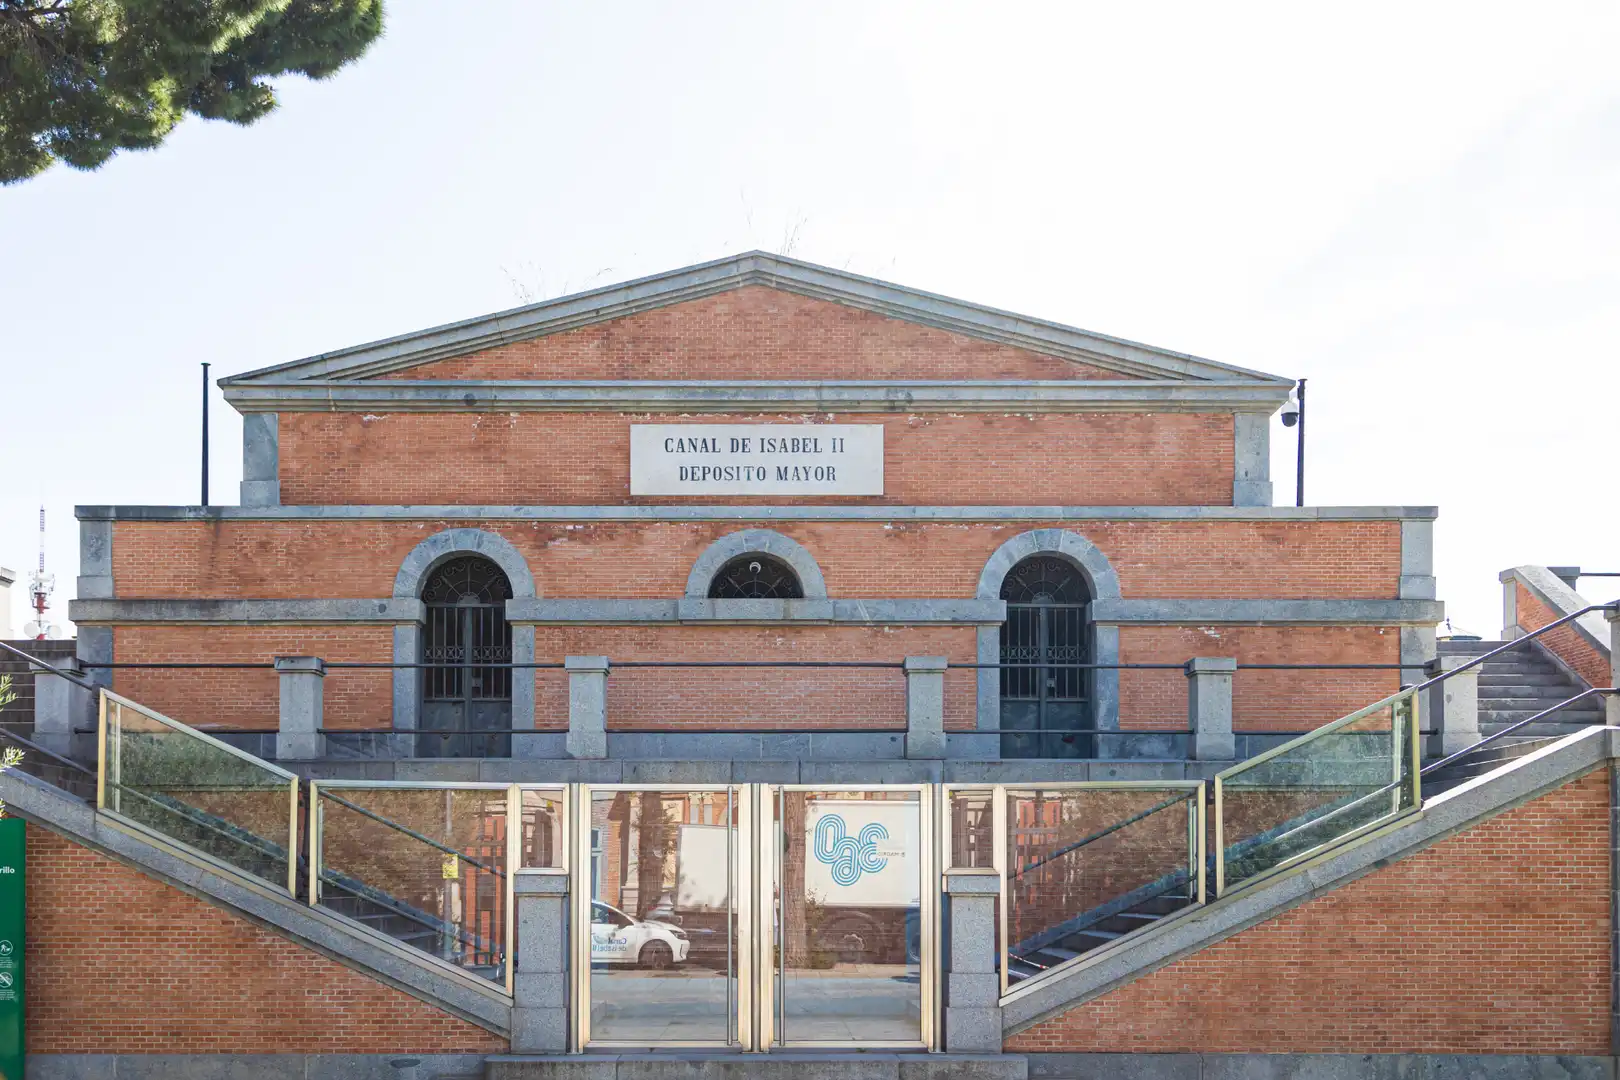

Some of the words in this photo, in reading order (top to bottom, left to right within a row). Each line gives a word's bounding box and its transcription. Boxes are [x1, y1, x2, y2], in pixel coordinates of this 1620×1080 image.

[664, 437, 722, 454] CANAL
[729, 437, 751, 454] DE
[759, 437, 823, 454] ISABEL
[831, 437, 845, 454] II
[679, 465, 767, 482] DEPOSITO
[775, 465, 837, 482] MAYOR
